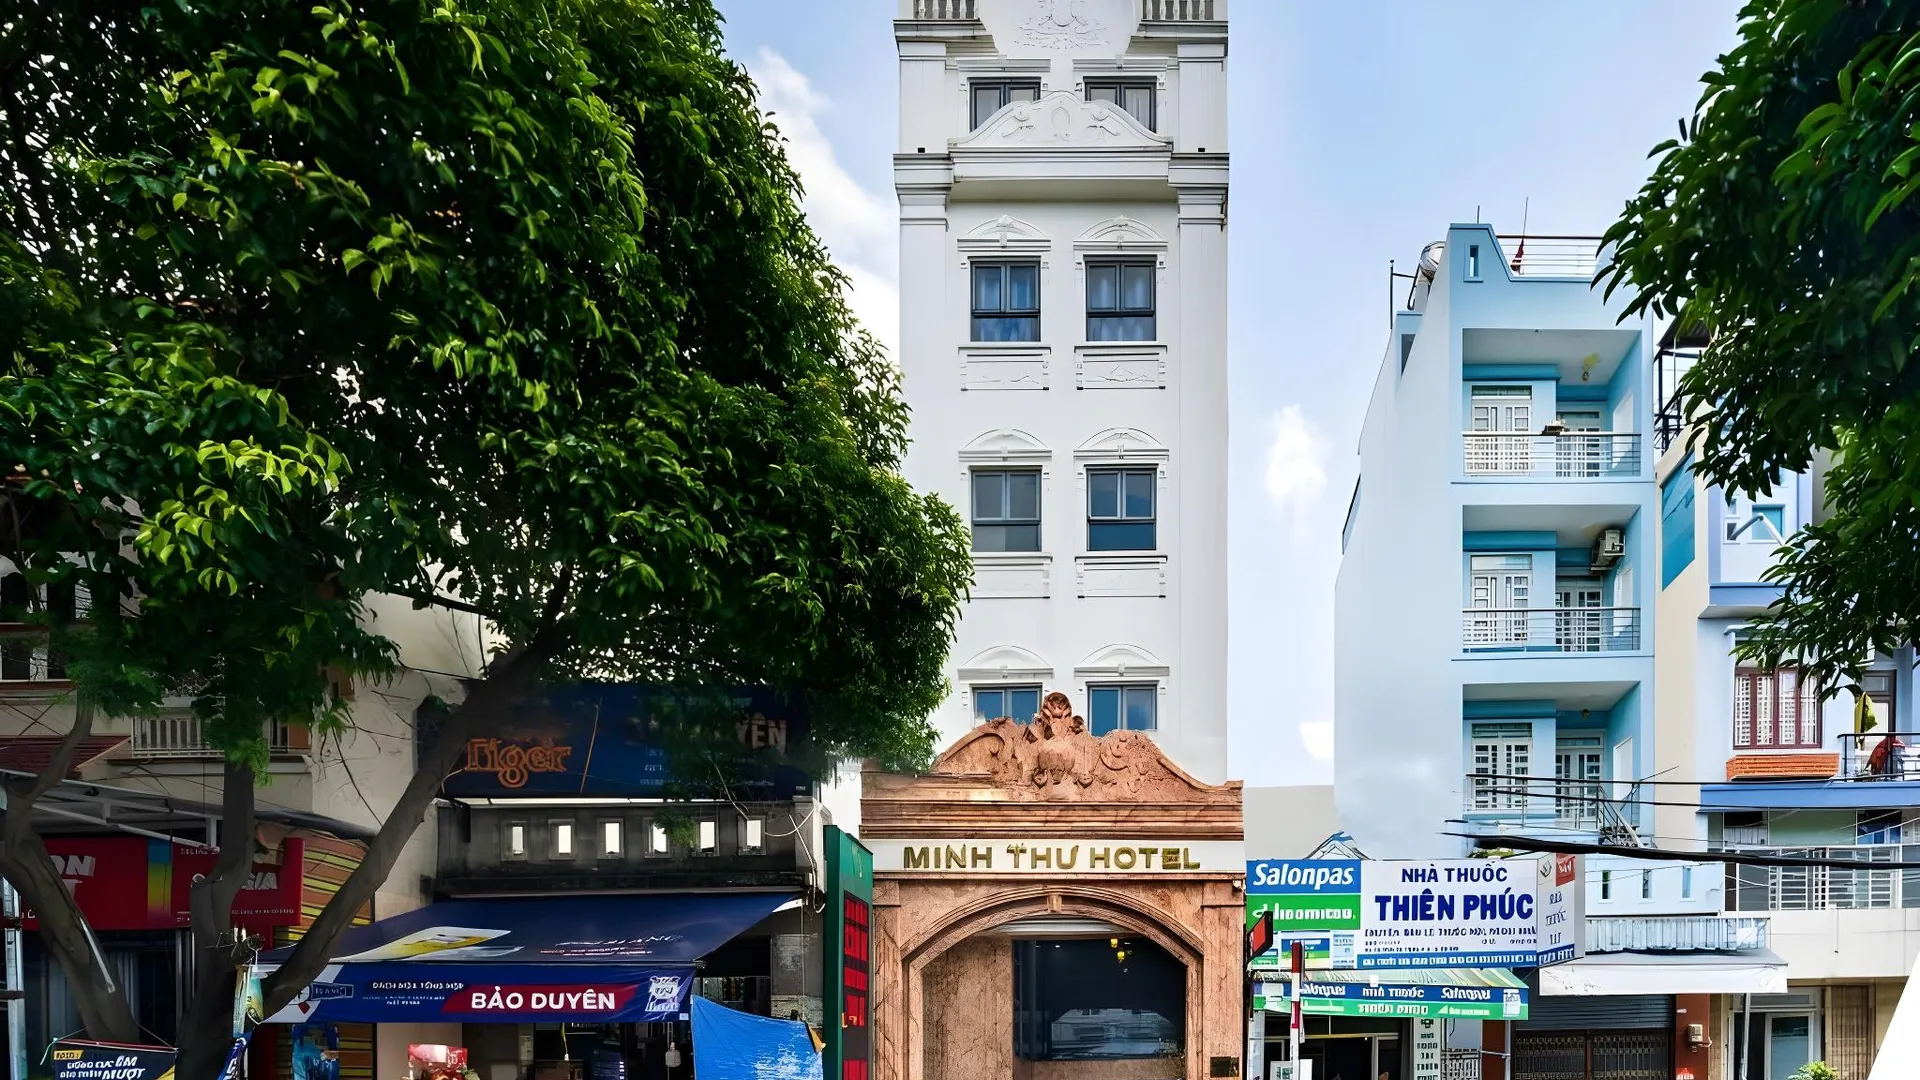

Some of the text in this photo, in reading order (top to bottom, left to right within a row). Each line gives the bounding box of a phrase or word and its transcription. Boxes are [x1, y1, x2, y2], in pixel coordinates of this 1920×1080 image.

[466, 737, 572, 788] Tiger
[903, 842, 1201, 870] MINH THƯ HOTEL
[1253, 863, 1354, 890] Salonpas
[1401, 861, 1508, 883] NHÀ THUỐC
[1374, 887, 1455, 922] THIÊN
[1463, 887, 1534, 921] PHÚC
[471, 985, 615, 1010] BẢO DUYÊN
